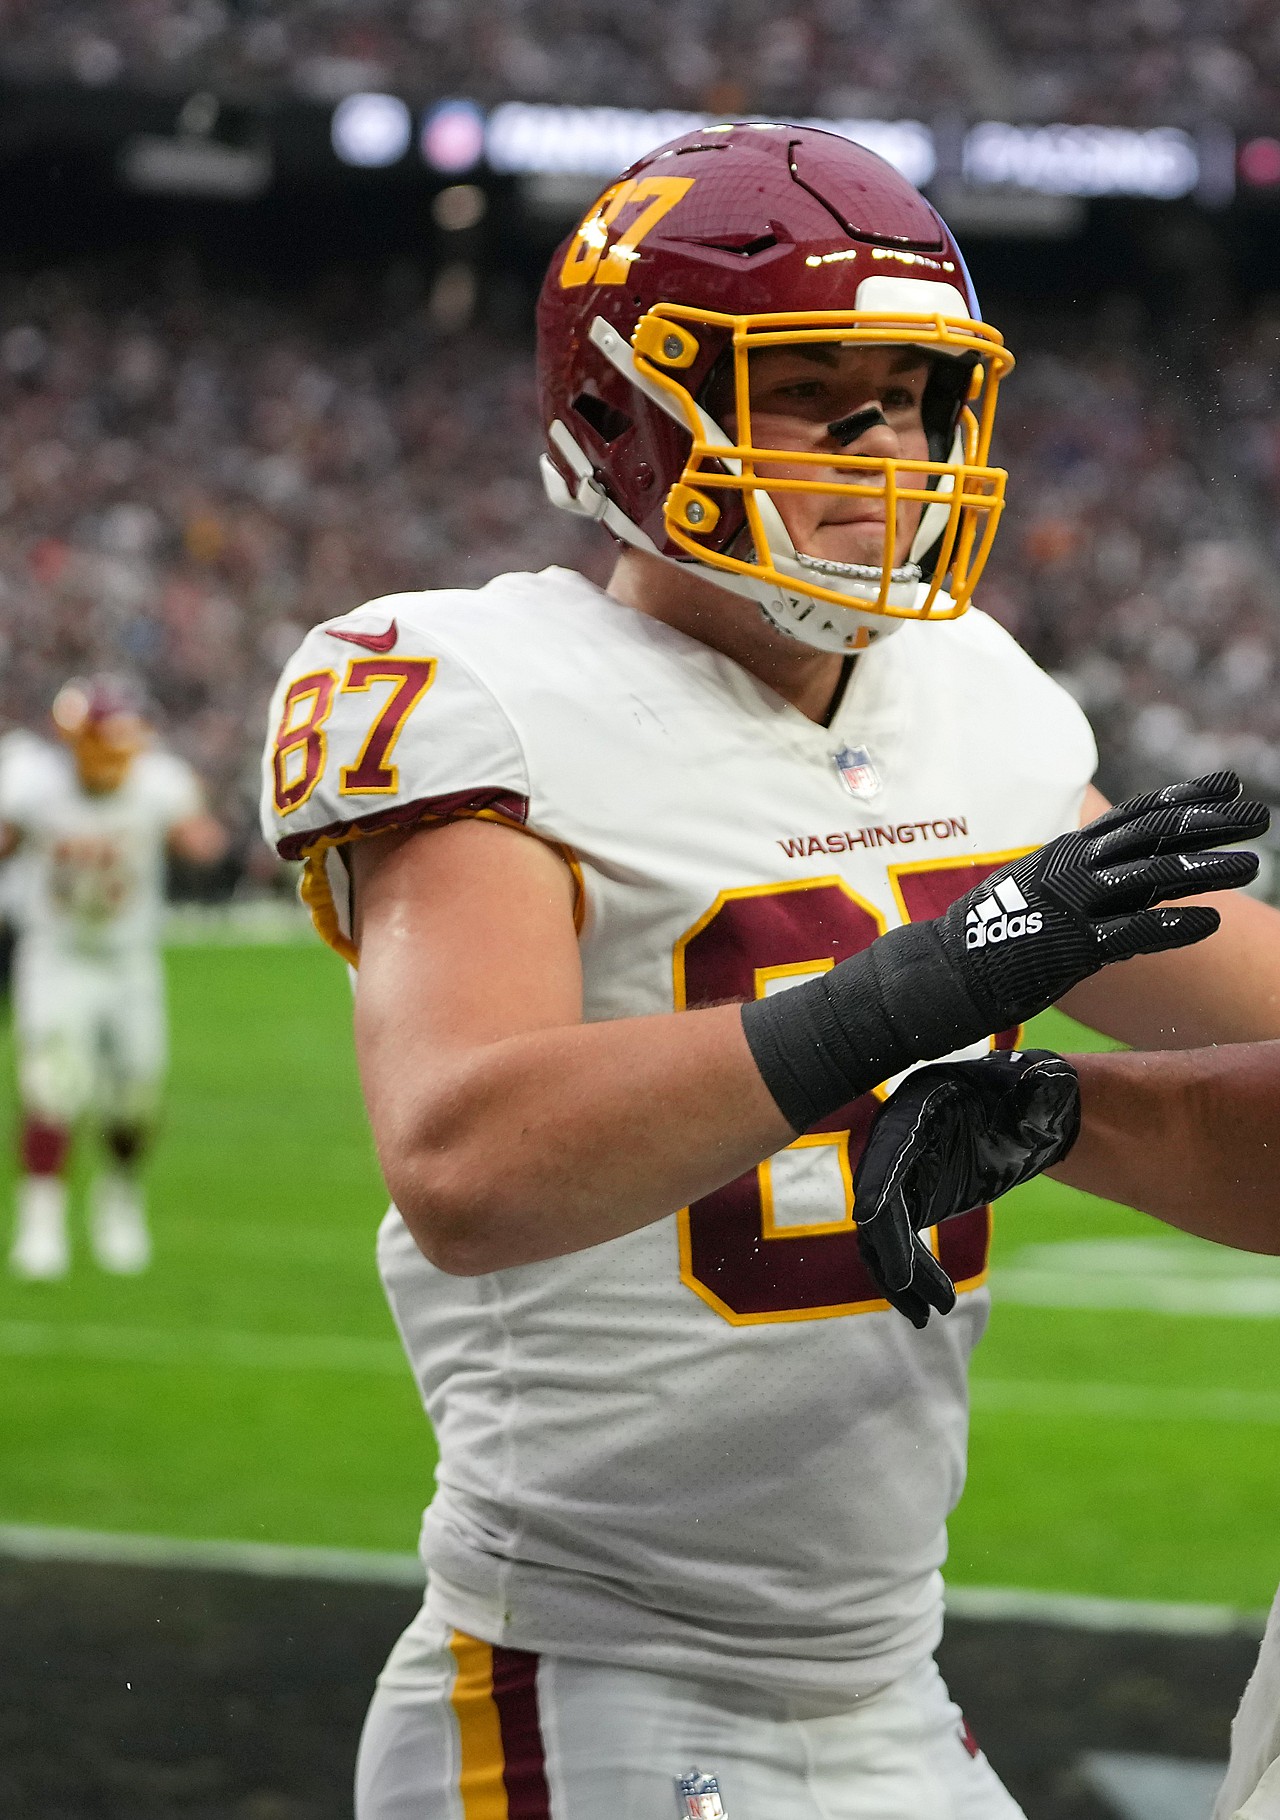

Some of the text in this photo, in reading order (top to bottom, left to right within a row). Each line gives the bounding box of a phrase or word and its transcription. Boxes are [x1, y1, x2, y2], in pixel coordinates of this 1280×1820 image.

[559, 176, 696, 289] 87
[272, 656, 437, 817] 87
[776, 815, 969, 859] WASHINGTON
[965, 911, 1043, 950] didas
